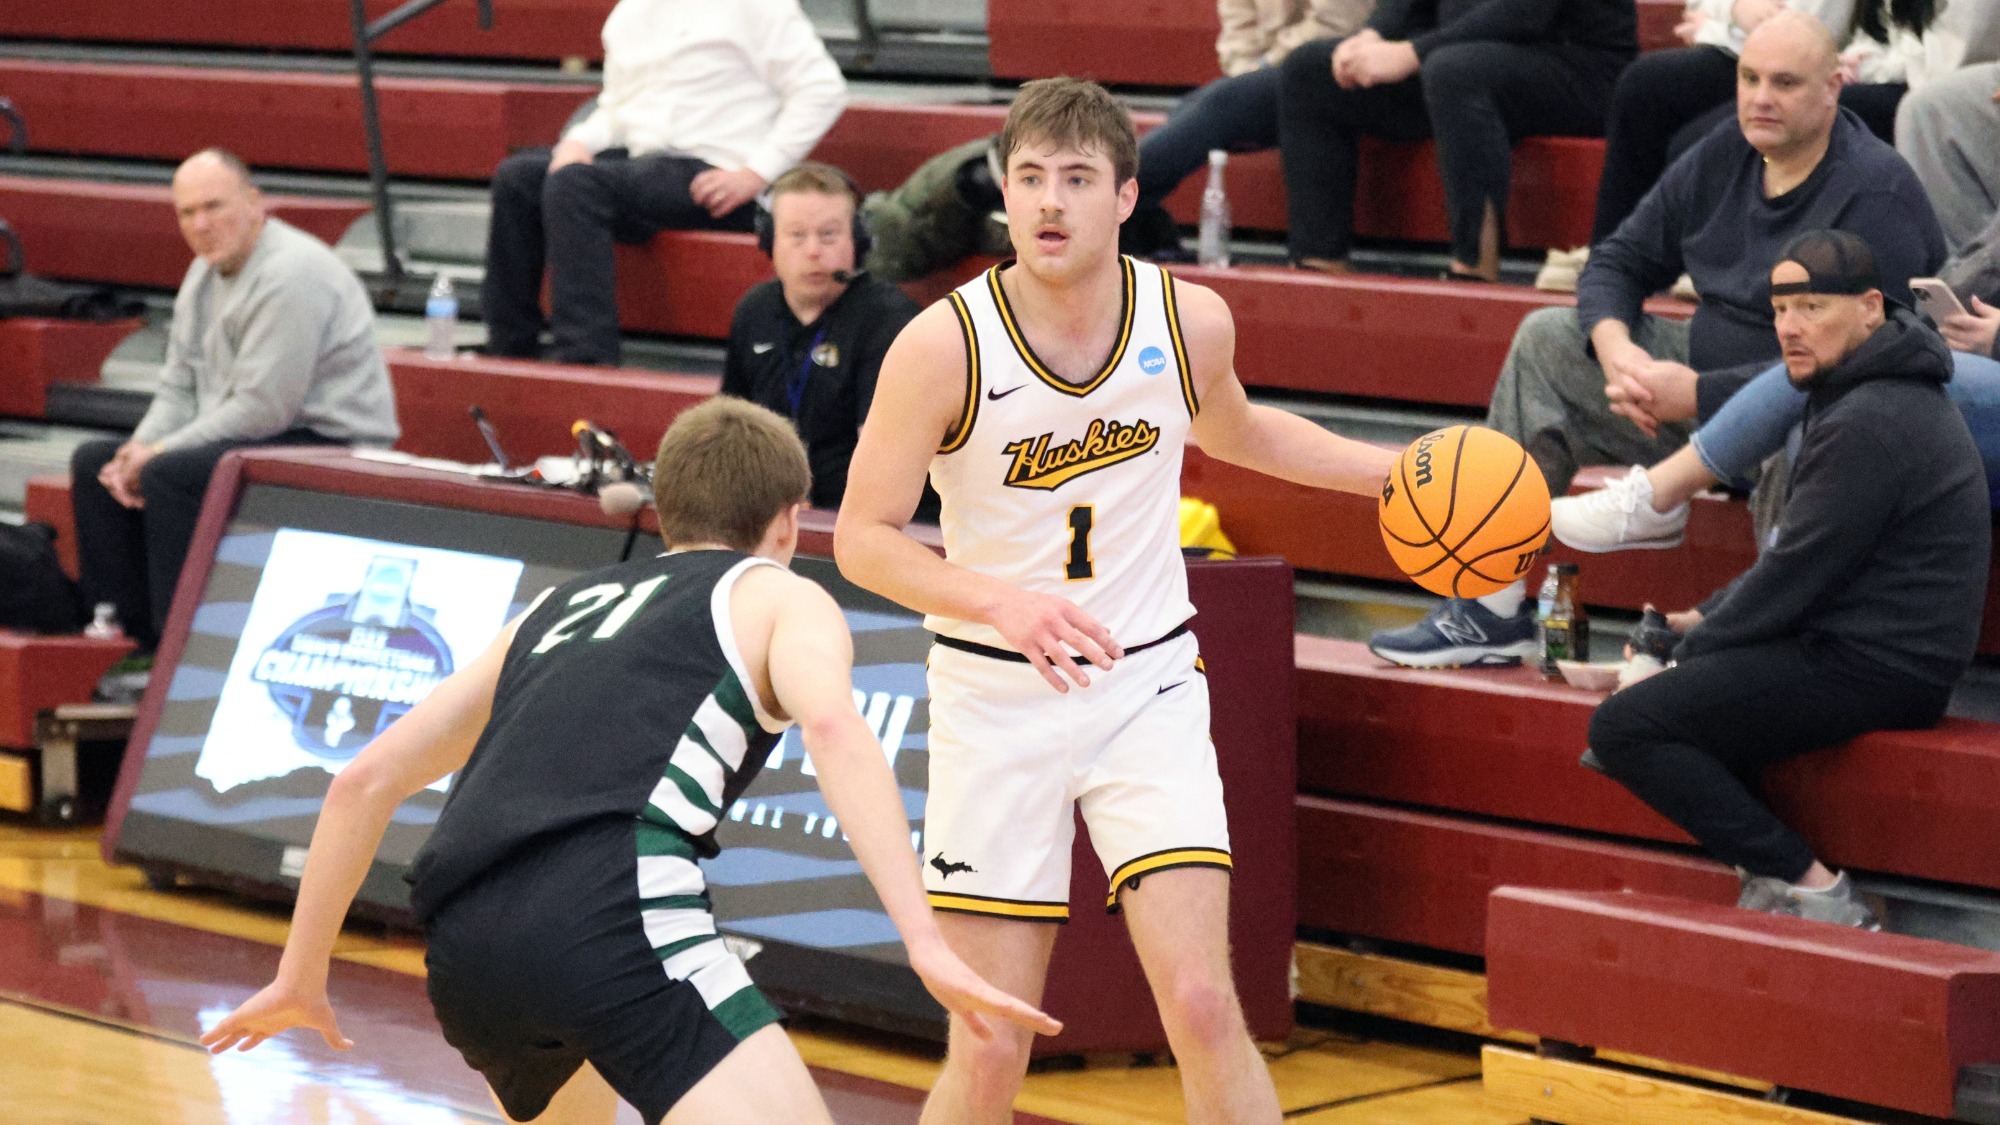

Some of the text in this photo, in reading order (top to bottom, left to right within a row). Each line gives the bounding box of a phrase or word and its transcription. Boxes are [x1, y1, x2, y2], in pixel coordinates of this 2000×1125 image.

[1143, 357, 1165, 369] NCAA
[1002, 418, 1159, 487] Huskies
[1415, 431, 1445, 489] lson
[1063, 503, 1095, 581] 1
[528, 573, 673, 658] 21
